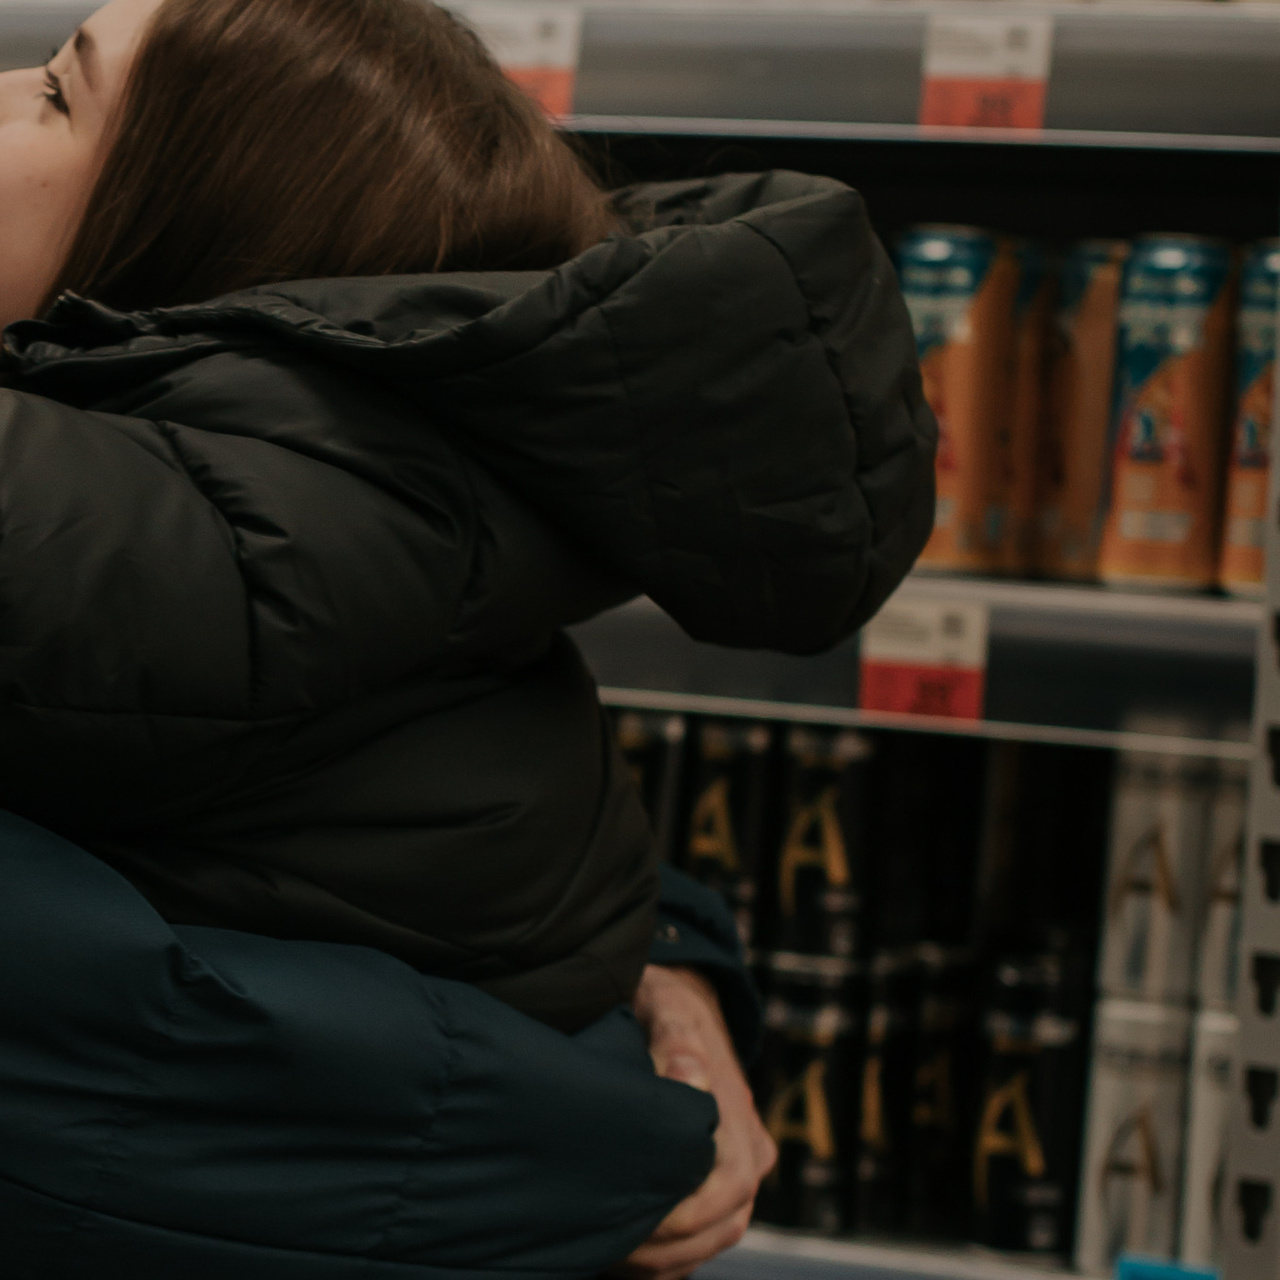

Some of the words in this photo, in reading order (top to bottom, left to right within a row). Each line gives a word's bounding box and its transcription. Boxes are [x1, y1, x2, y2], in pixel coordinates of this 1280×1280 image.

[777, 786, 850, 918] A
[1110, 822, 1180, 916] A
[766, 1058, 837, 1182] A
[973, 1070, 1046, 1213] A
[1097, 1105, 1162, 1200] A
